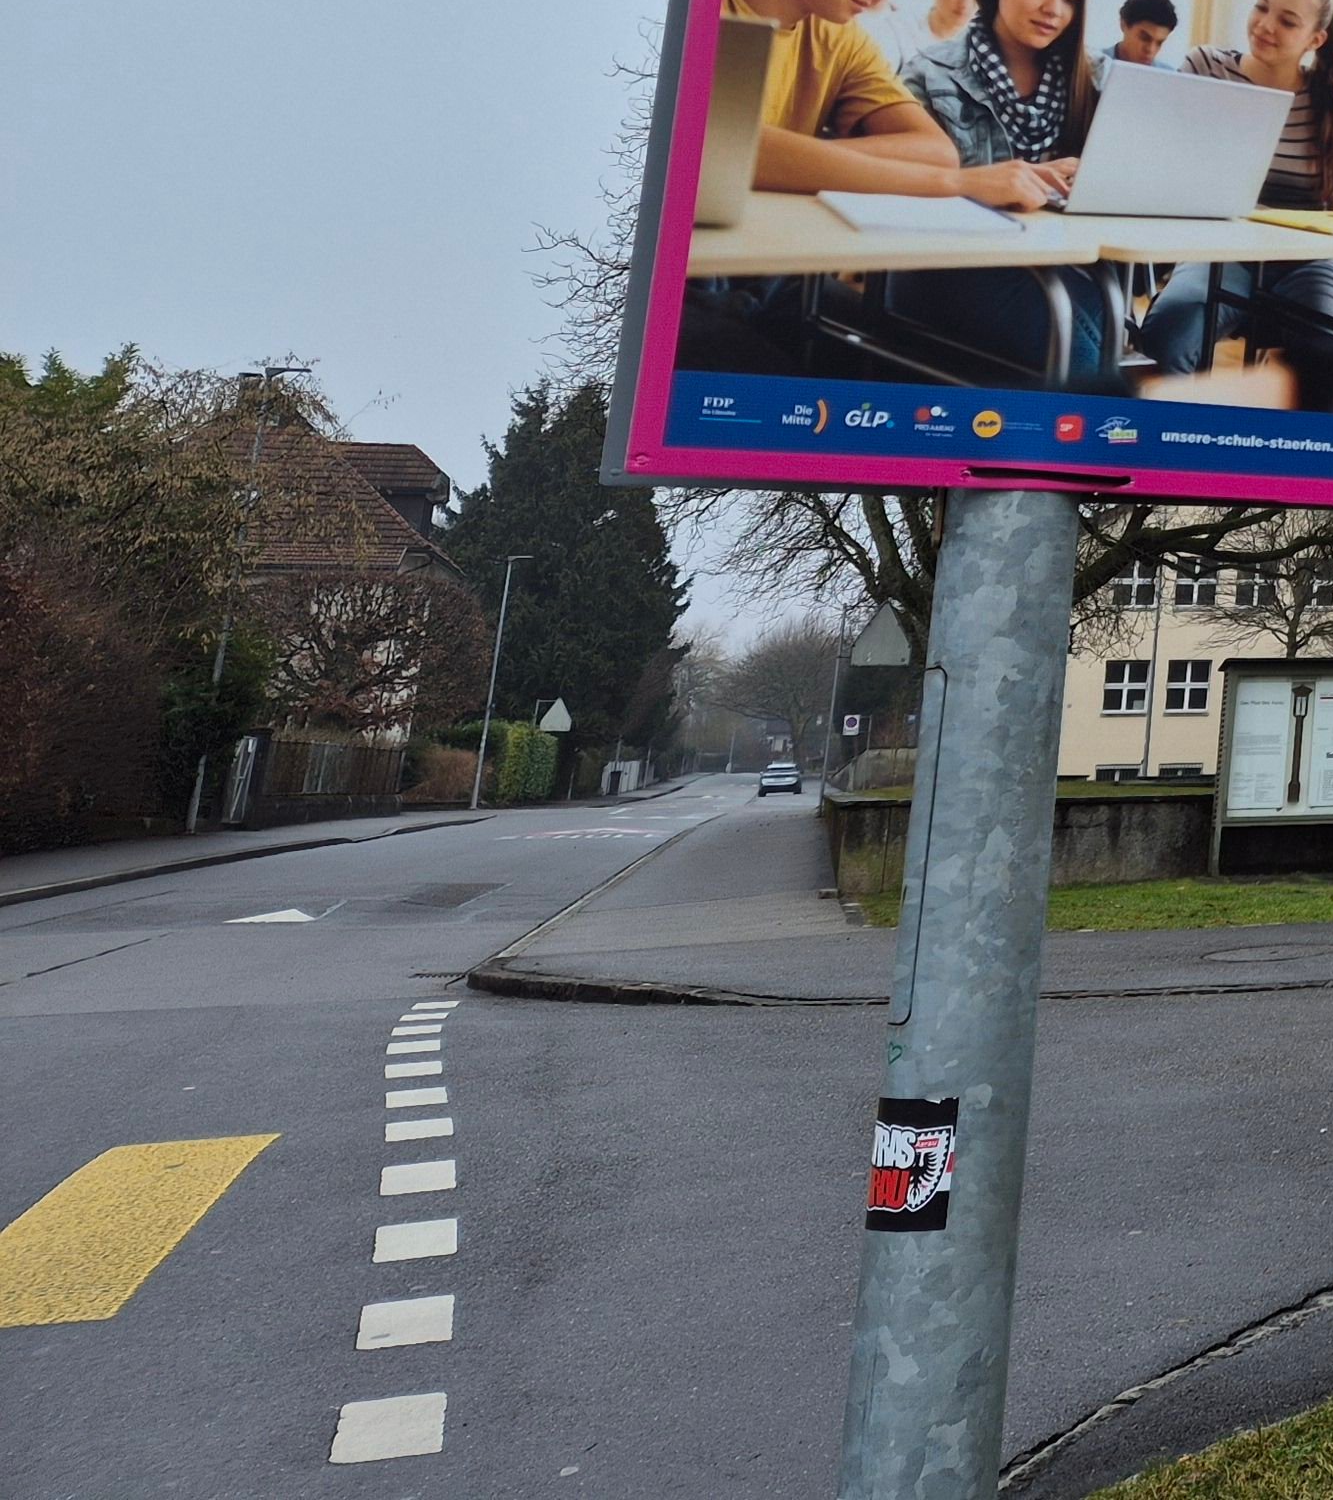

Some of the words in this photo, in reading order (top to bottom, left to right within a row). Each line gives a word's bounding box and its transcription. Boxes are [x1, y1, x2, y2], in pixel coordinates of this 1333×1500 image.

[703, 396, 735, 409] FDP
[794, 405, 813, 416] Die
[781, 414, 812, 427] Mitte
[844, 409, 890, 428] GLP
